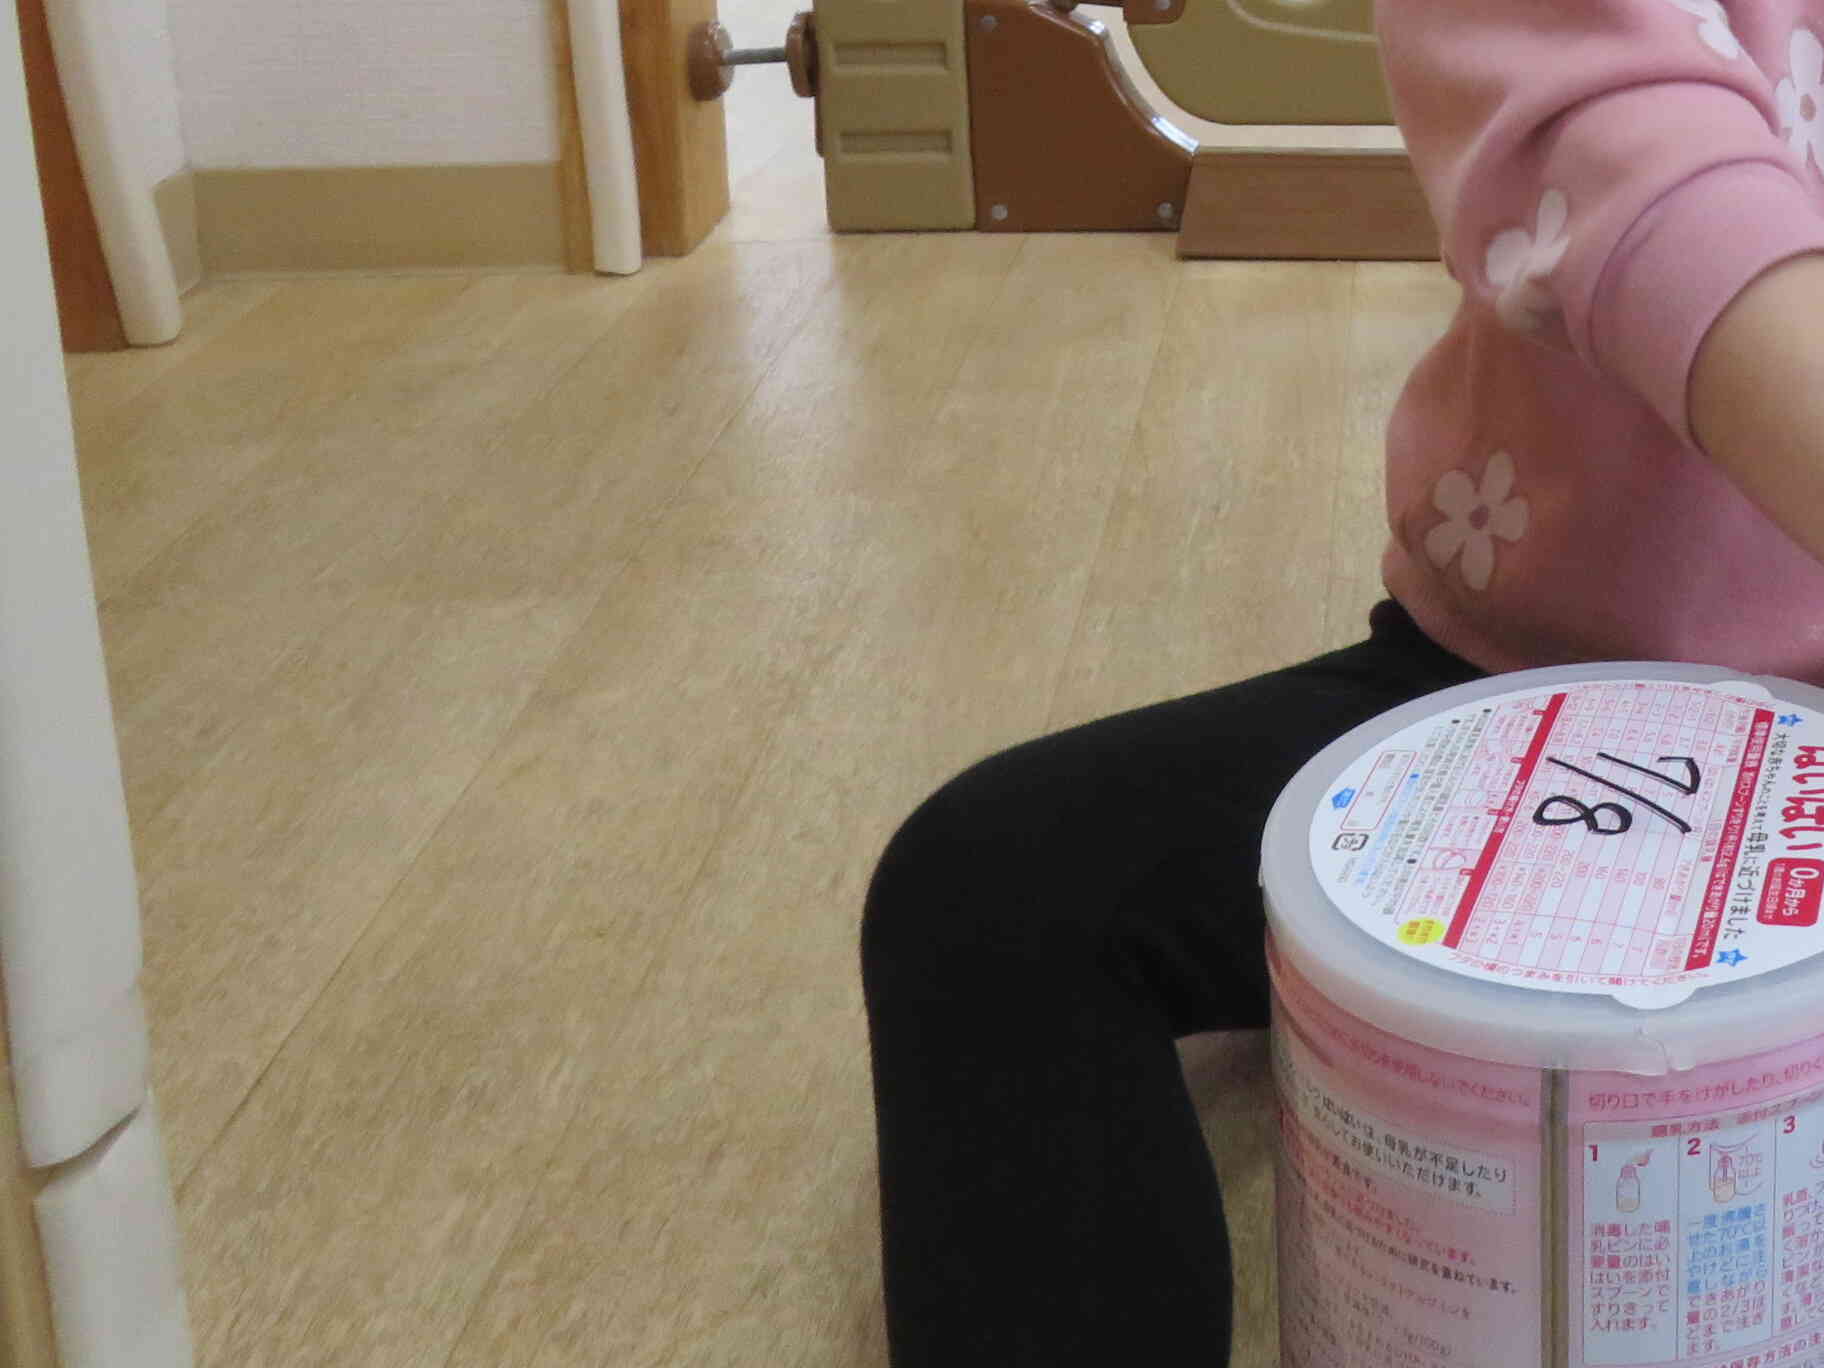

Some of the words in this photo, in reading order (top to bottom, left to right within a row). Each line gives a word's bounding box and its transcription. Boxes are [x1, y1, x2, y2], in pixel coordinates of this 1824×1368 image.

[1532, 751, 1701, 835] 7/8
[1782, 1115, 1797, 1134] 3
[1589, 1144, 1600, 1162] 1
[1687, 1138, 1701, 1156] 2
